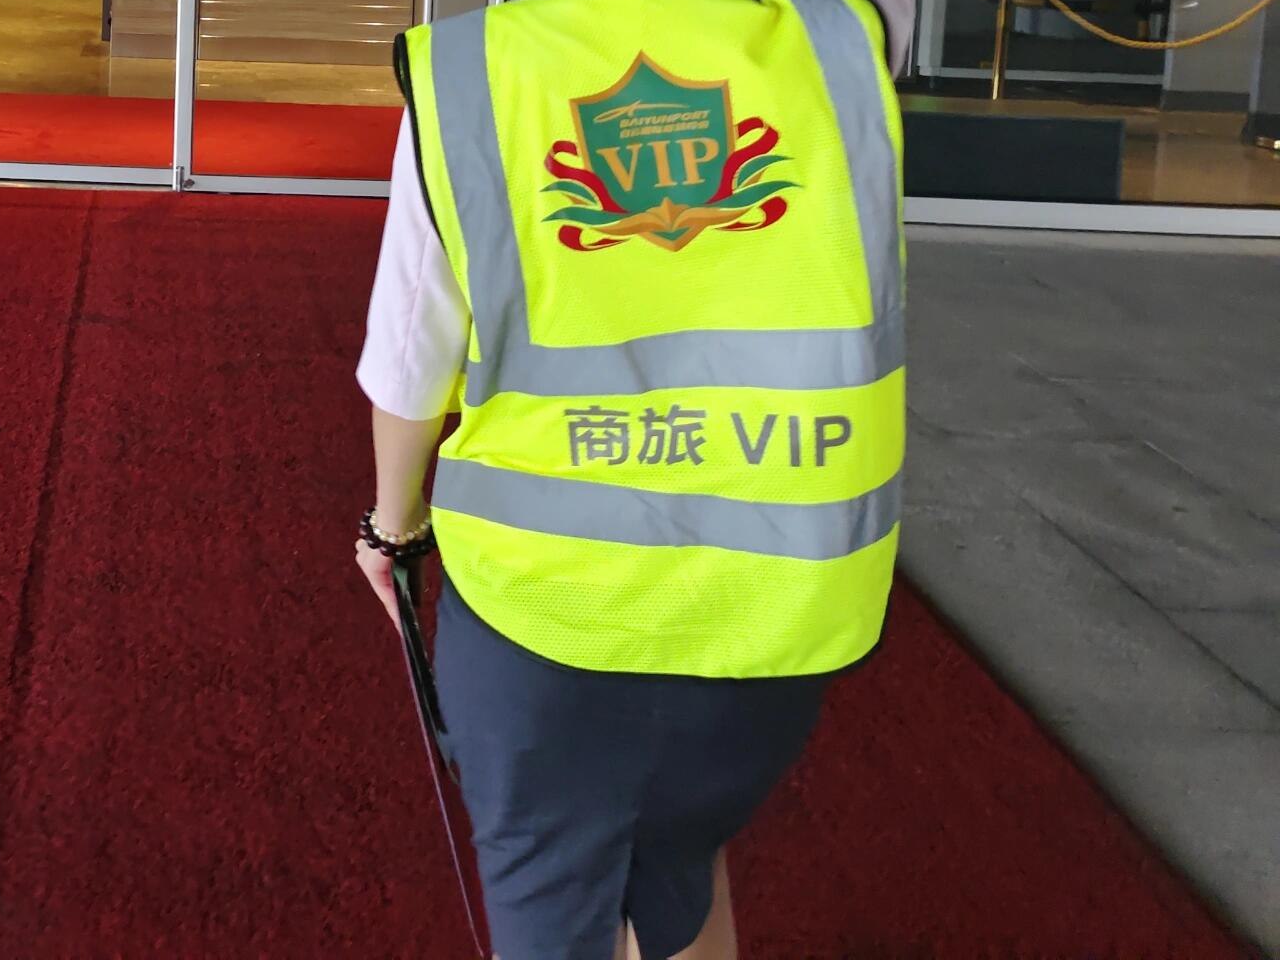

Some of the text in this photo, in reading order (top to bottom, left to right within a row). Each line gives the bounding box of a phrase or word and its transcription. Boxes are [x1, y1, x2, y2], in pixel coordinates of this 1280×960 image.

[595, 137, 719, 193] VIP
[564, 404, 852, 468] 商旅 VIP
